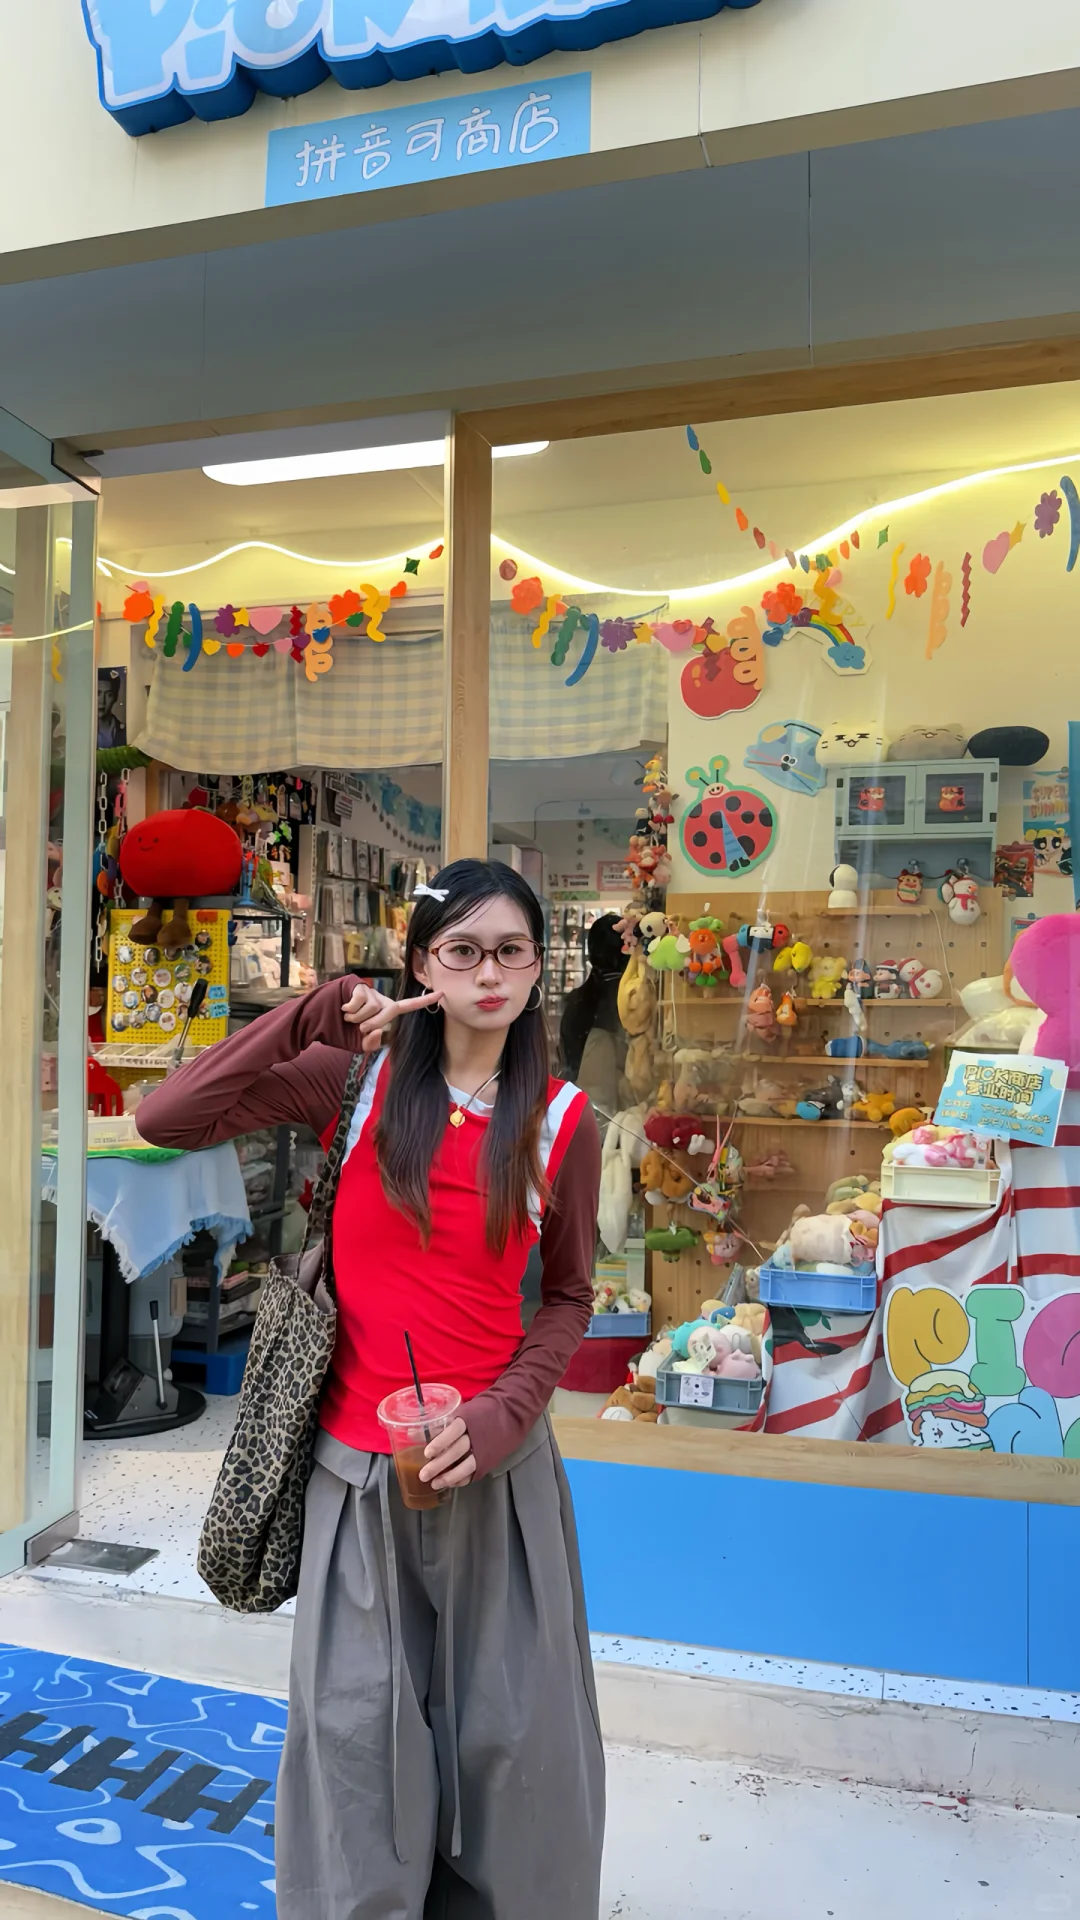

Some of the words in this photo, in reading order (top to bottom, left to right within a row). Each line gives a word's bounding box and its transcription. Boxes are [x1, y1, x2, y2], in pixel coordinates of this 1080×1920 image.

[295, 92, 559, 189] 拼音可商店
[965, 1065, 1044, 1090] PICK商店
